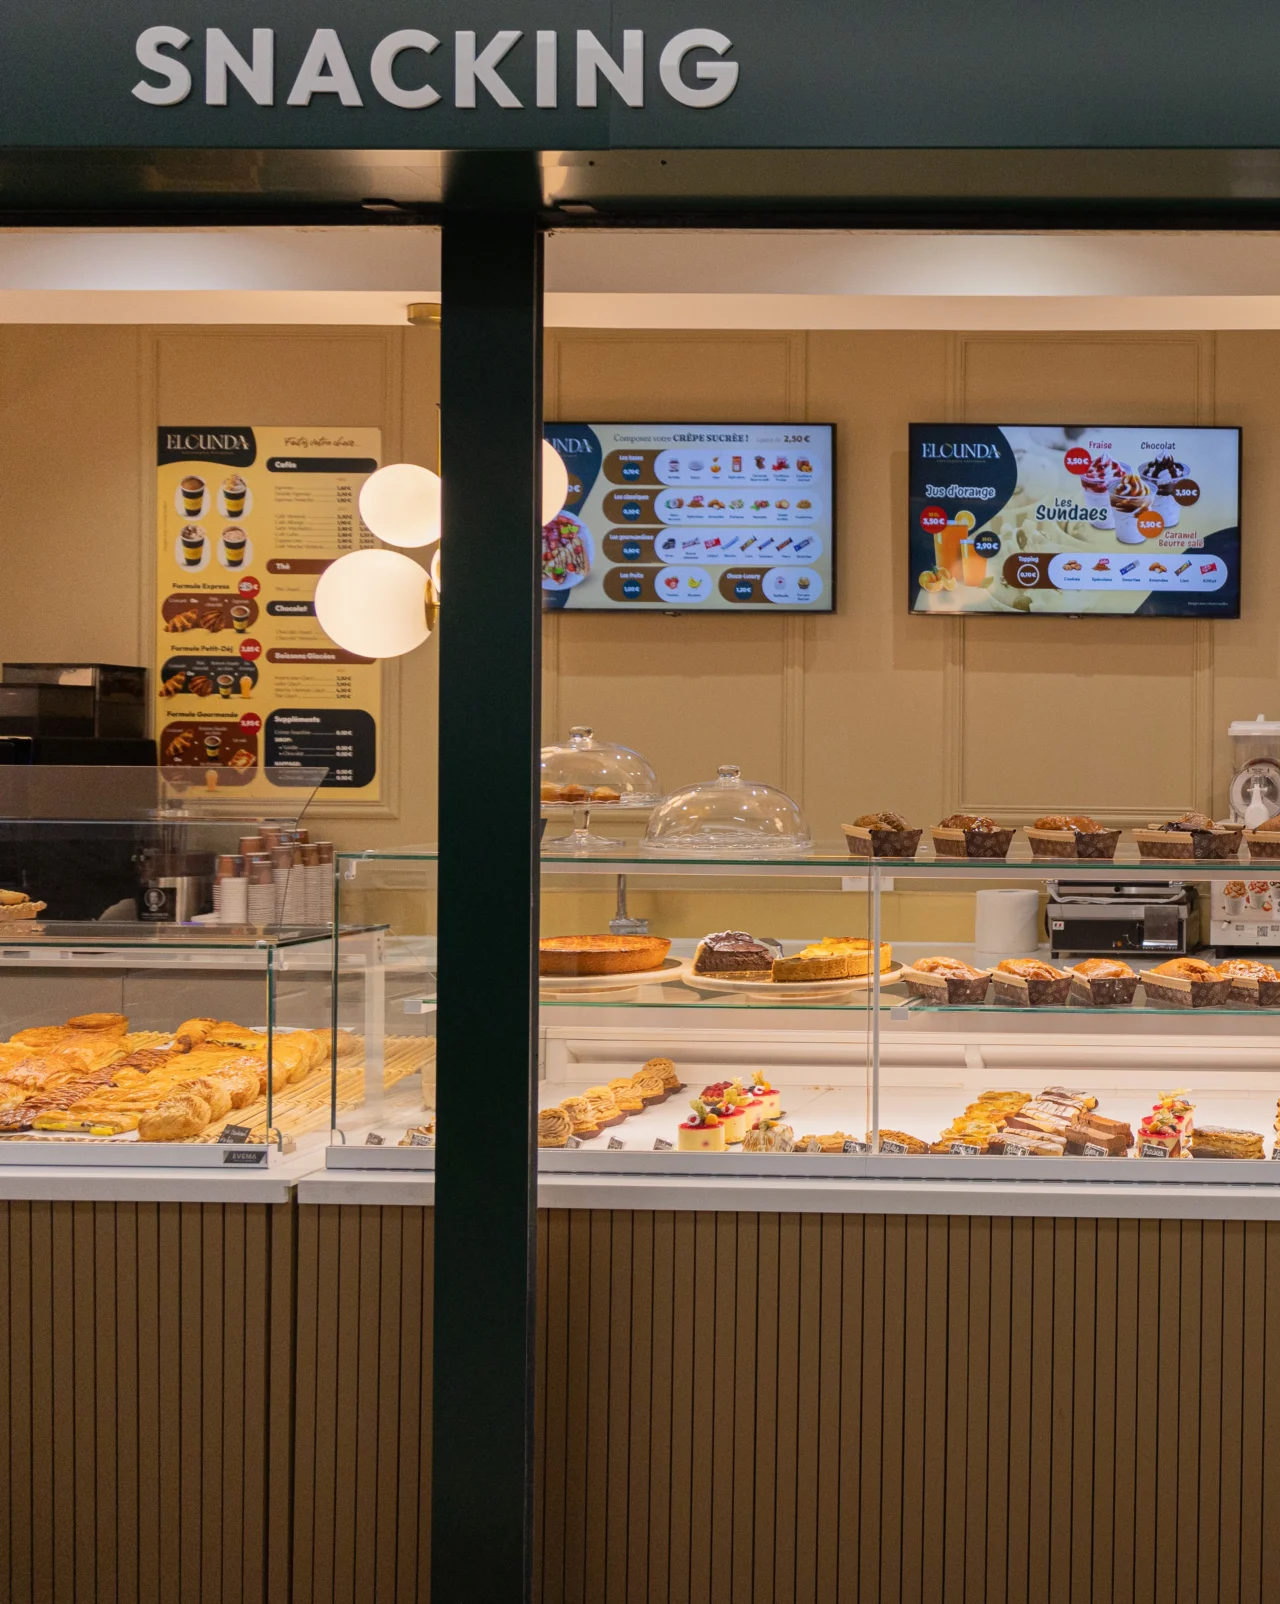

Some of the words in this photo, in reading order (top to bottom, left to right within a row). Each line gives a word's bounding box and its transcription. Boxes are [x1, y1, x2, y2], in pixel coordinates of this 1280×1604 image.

[131, 25, 740, 110] SNACKING
[613, 433, 651, 444] Composez
[1088, 441, 1112, 450] Fraise
[1140, 442, 1176, 450] Chocolat
[926, 484, 945, 498] Jus
[946, 484, 996, 500] d'orange
[1055, 497, 1073, 507] Les
[1035, 504, 1108, 521] Sundaes
[1164, 531, 1197, 539] Caramel
[1158, 539, 1186, 547] Beurre
[1187, 539, 1205, 548] salé
[1018, 556, 1039, 564] Topping
